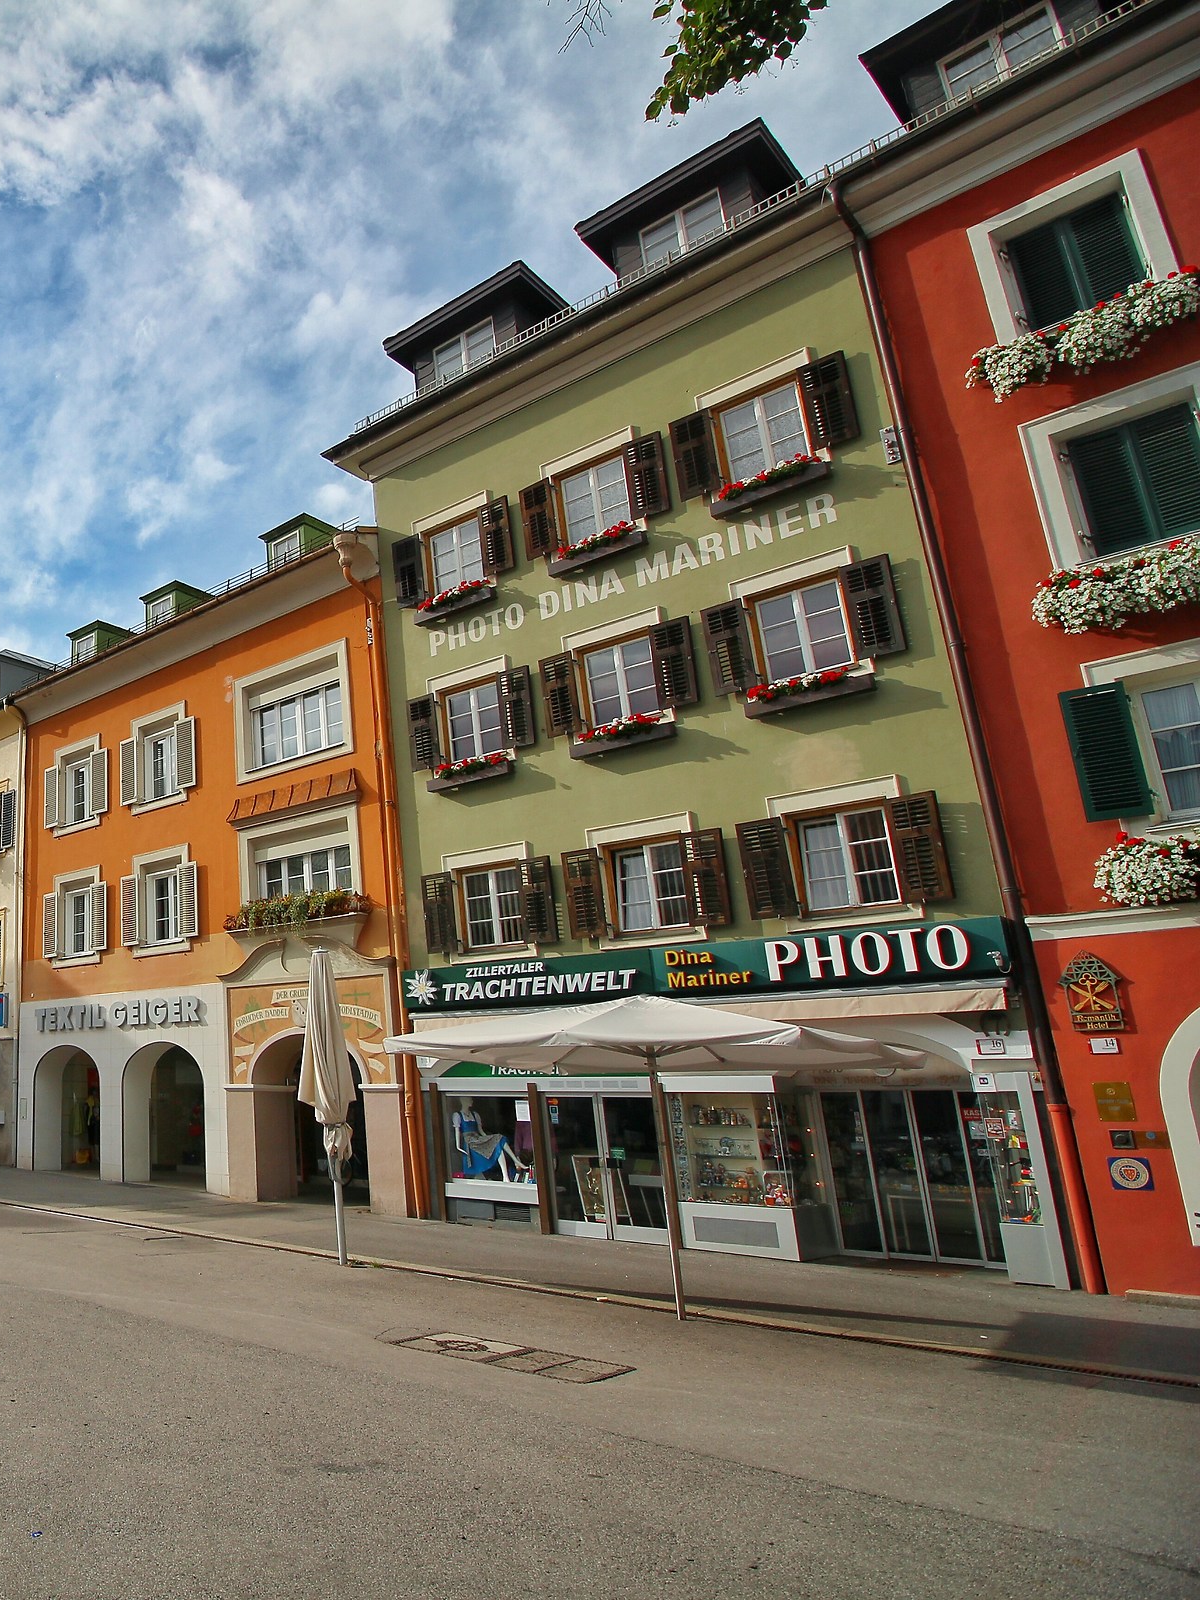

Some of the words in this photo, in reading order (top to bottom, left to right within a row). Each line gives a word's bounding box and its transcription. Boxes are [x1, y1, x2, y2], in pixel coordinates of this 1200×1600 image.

[428, 600, 525, 657] PHOTO
[538, 567, 626, 621] DINA
[634, 493, 838, 588] MARINER
[664, 949, 713, 967] Dina
[764, 924, 970, 982] PHOTO
[465, 961, 545, 979] ZILLERTALER
[667, 968, 753, 989] Mariner
[441, 968, 637, 1002] TRACHTENWELT
[34, 1003, 106, 1033] TEXTIL
[109, 995, 200, 1028] GEIGER
[339, 1005, 379, 1022] OHLSTANDS
[1086, 1021, 1109, 1029] Hotel
[991, 1040, 1002, 1048] 16
[1104, 1038, 1116, 1047] 14
